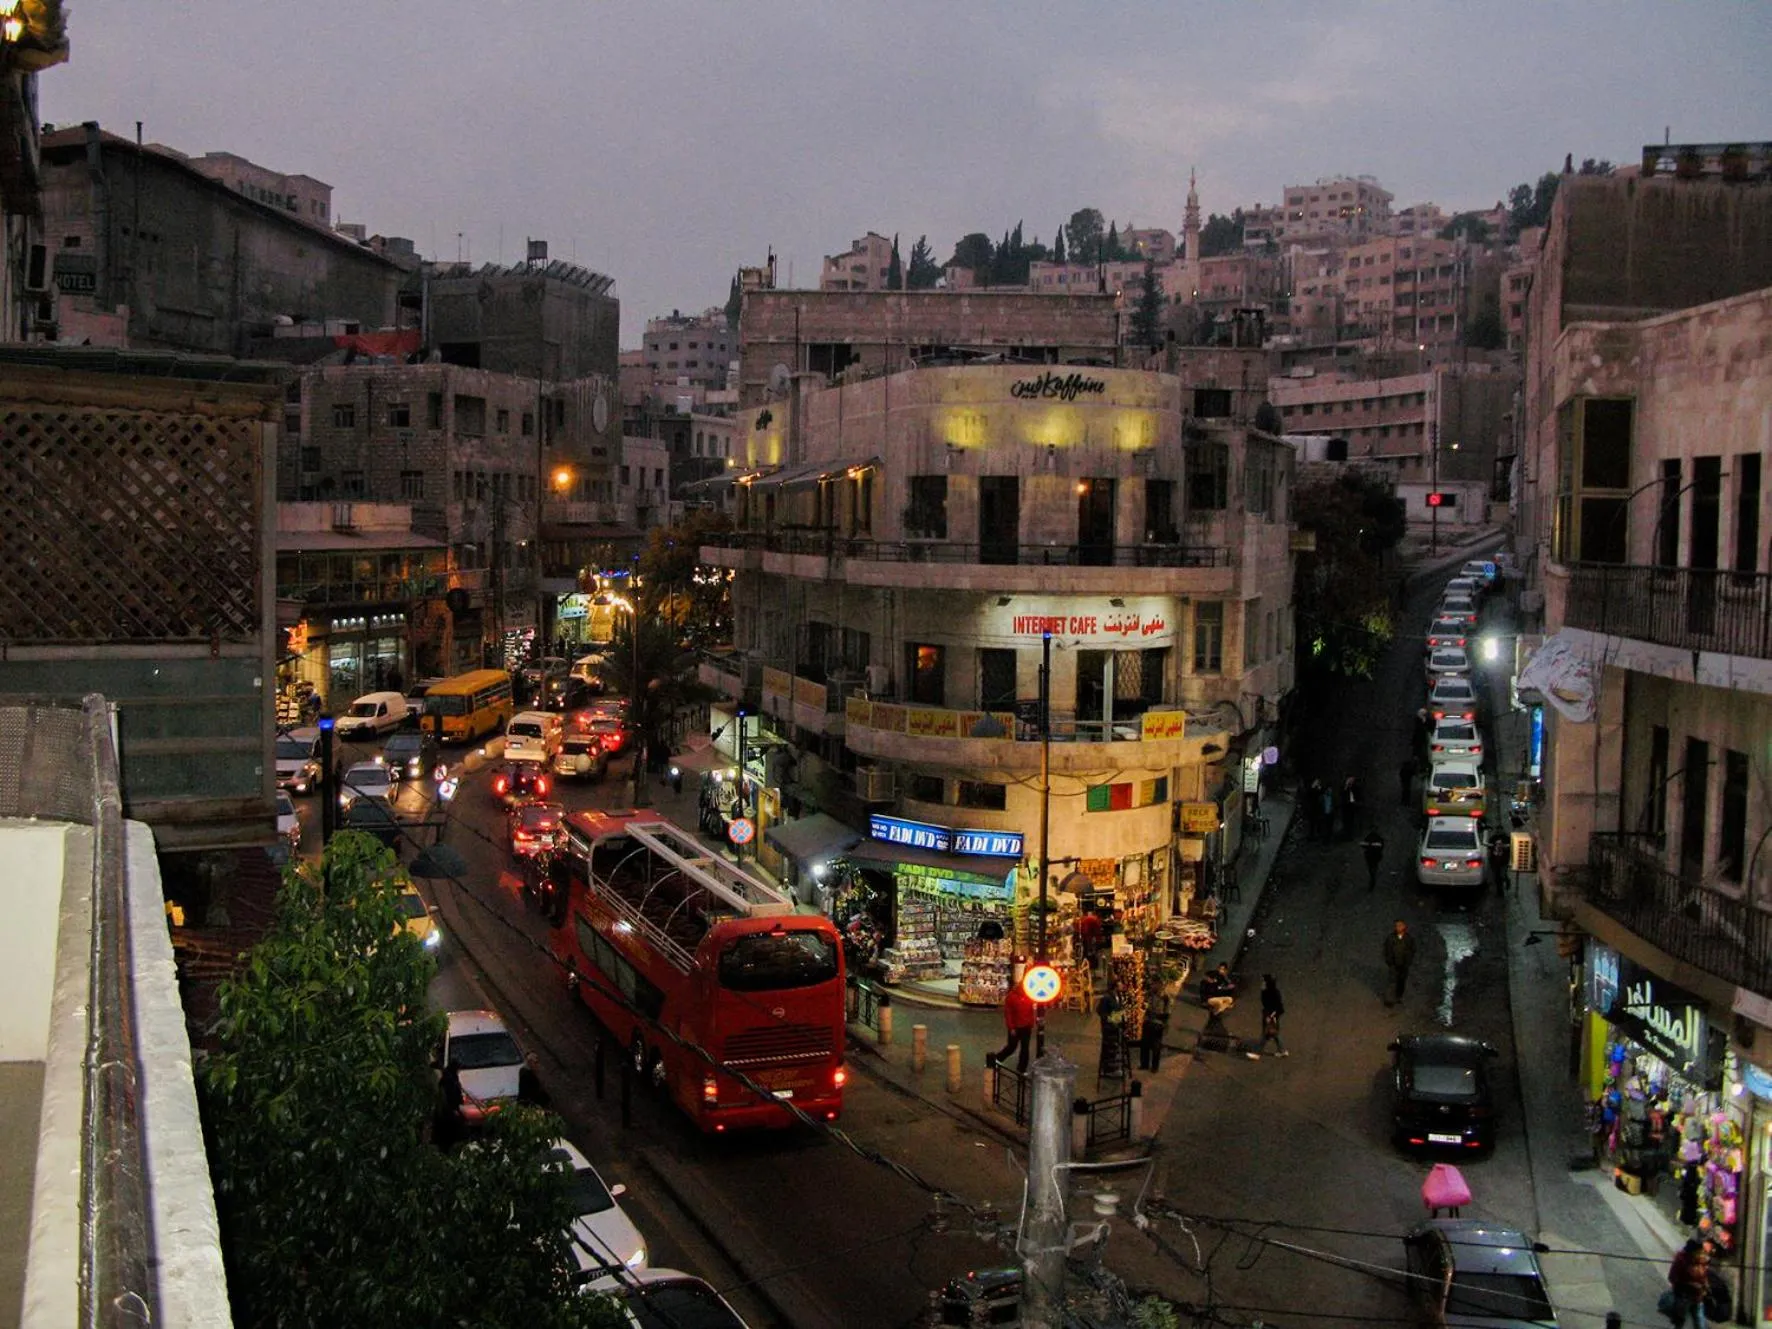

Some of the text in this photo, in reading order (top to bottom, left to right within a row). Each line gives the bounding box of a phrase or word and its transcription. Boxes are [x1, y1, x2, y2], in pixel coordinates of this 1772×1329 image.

[57, 274, 95, 289] HOTEL
[1042, 371, 1105, 402] Kaffeine
[1013, 616, 1097, 634] INTERNET CAFE
[889, 825, 913, 844] FADI
[914, 830, 936, 848] DVD
[955, 835, 989, 851] FADI
[991, 838, 1021, 853] DVD
